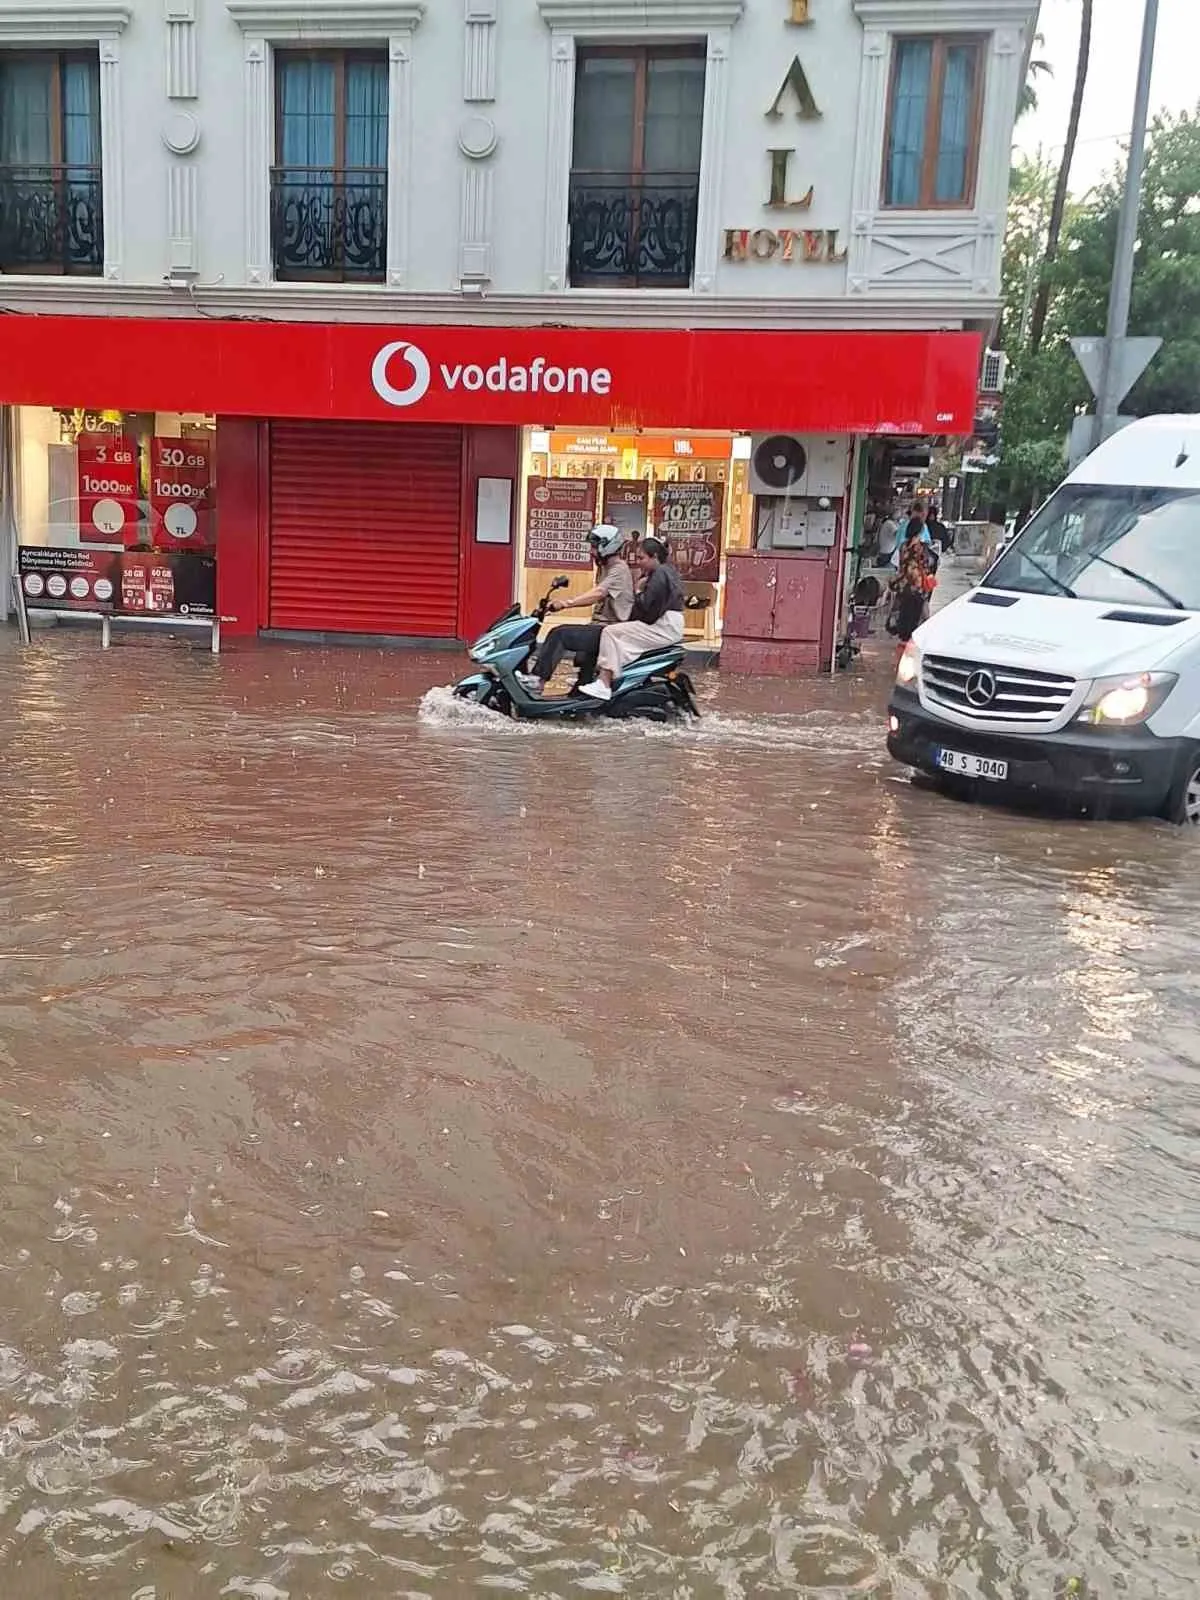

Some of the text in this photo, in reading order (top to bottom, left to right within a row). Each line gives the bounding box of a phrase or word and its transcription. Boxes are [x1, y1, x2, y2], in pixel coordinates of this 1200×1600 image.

[721, 228, 848, 262] HOTEL
[440, 356, 612, 395] vodafone
[95, 445, 133, 463] 3 GB
[161, 448, 206, 466] 30 GB
[662, 504, 712, 521] 10 GB
[103, 522, 115, 531] TL
[175, 526, 187, 535] TL
[941, 749, 1005, 777] 48 S 3040
